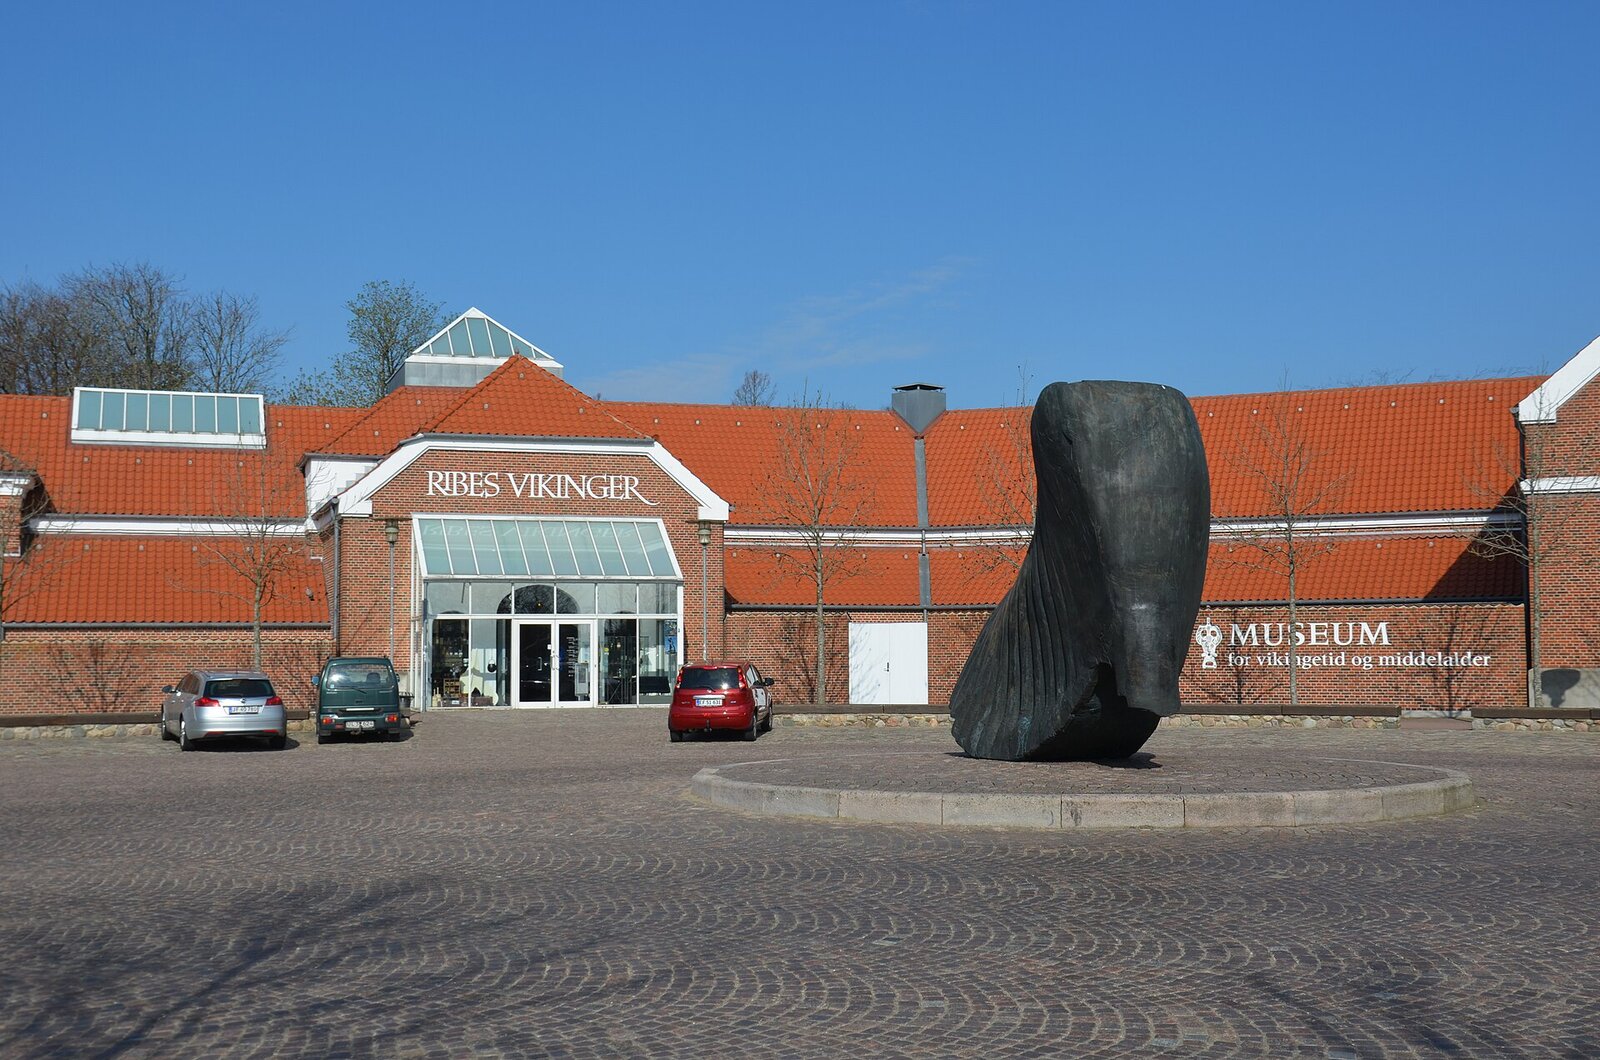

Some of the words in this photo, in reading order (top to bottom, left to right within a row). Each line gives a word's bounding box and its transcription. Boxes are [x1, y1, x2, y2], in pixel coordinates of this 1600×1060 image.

[426, 470, 500, 498] RIBES
[505, 472, 660, 505] VIKINGER
[1229, 621, 1391, 646] MUSEUM
[1228, 651, 1251, 667] for
[1351, 654, 1373, 670] og
[1378, 651, 1491, 668] middelalder
